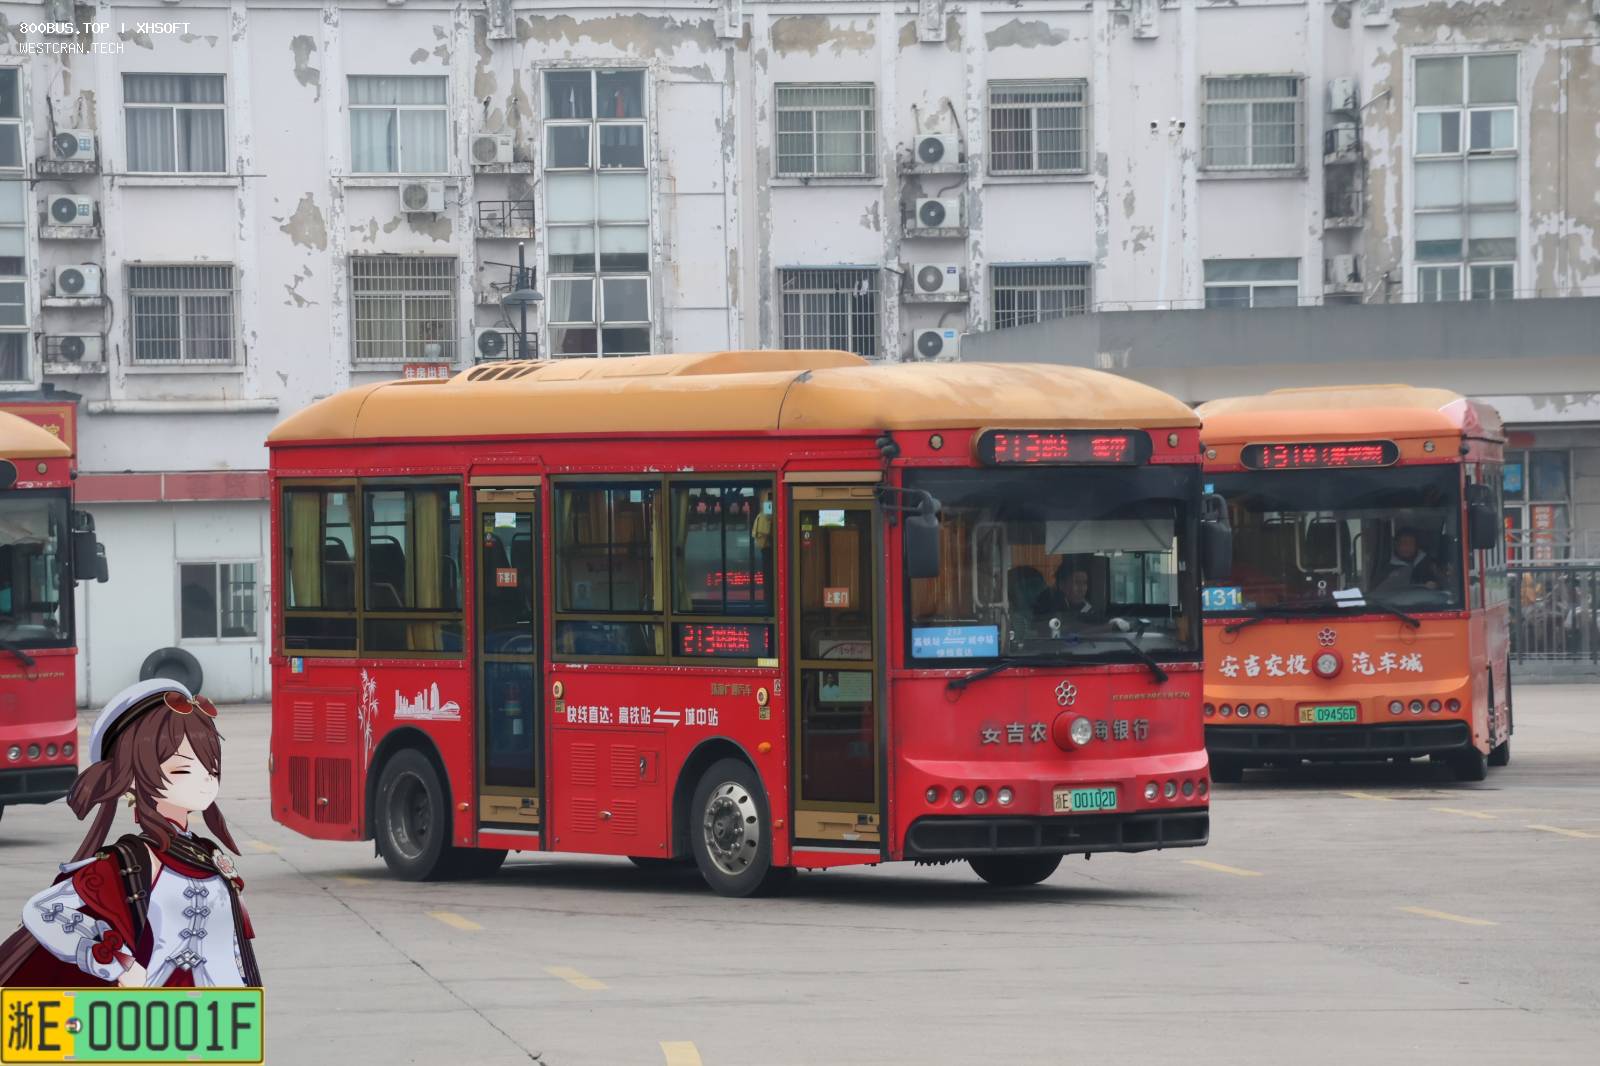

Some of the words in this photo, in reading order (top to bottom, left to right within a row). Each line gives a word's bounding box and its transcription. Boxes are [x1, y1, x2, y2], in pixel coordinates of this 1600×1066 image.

[1201, 588, 1237, 606] 131
[1218, 654, 1312, 678] 安吉交投
[1352, 651, 1424, 676] 汽车城
[619, 706, 650, 724] 高铁站
[685, 707, 718, 726] 城中站
